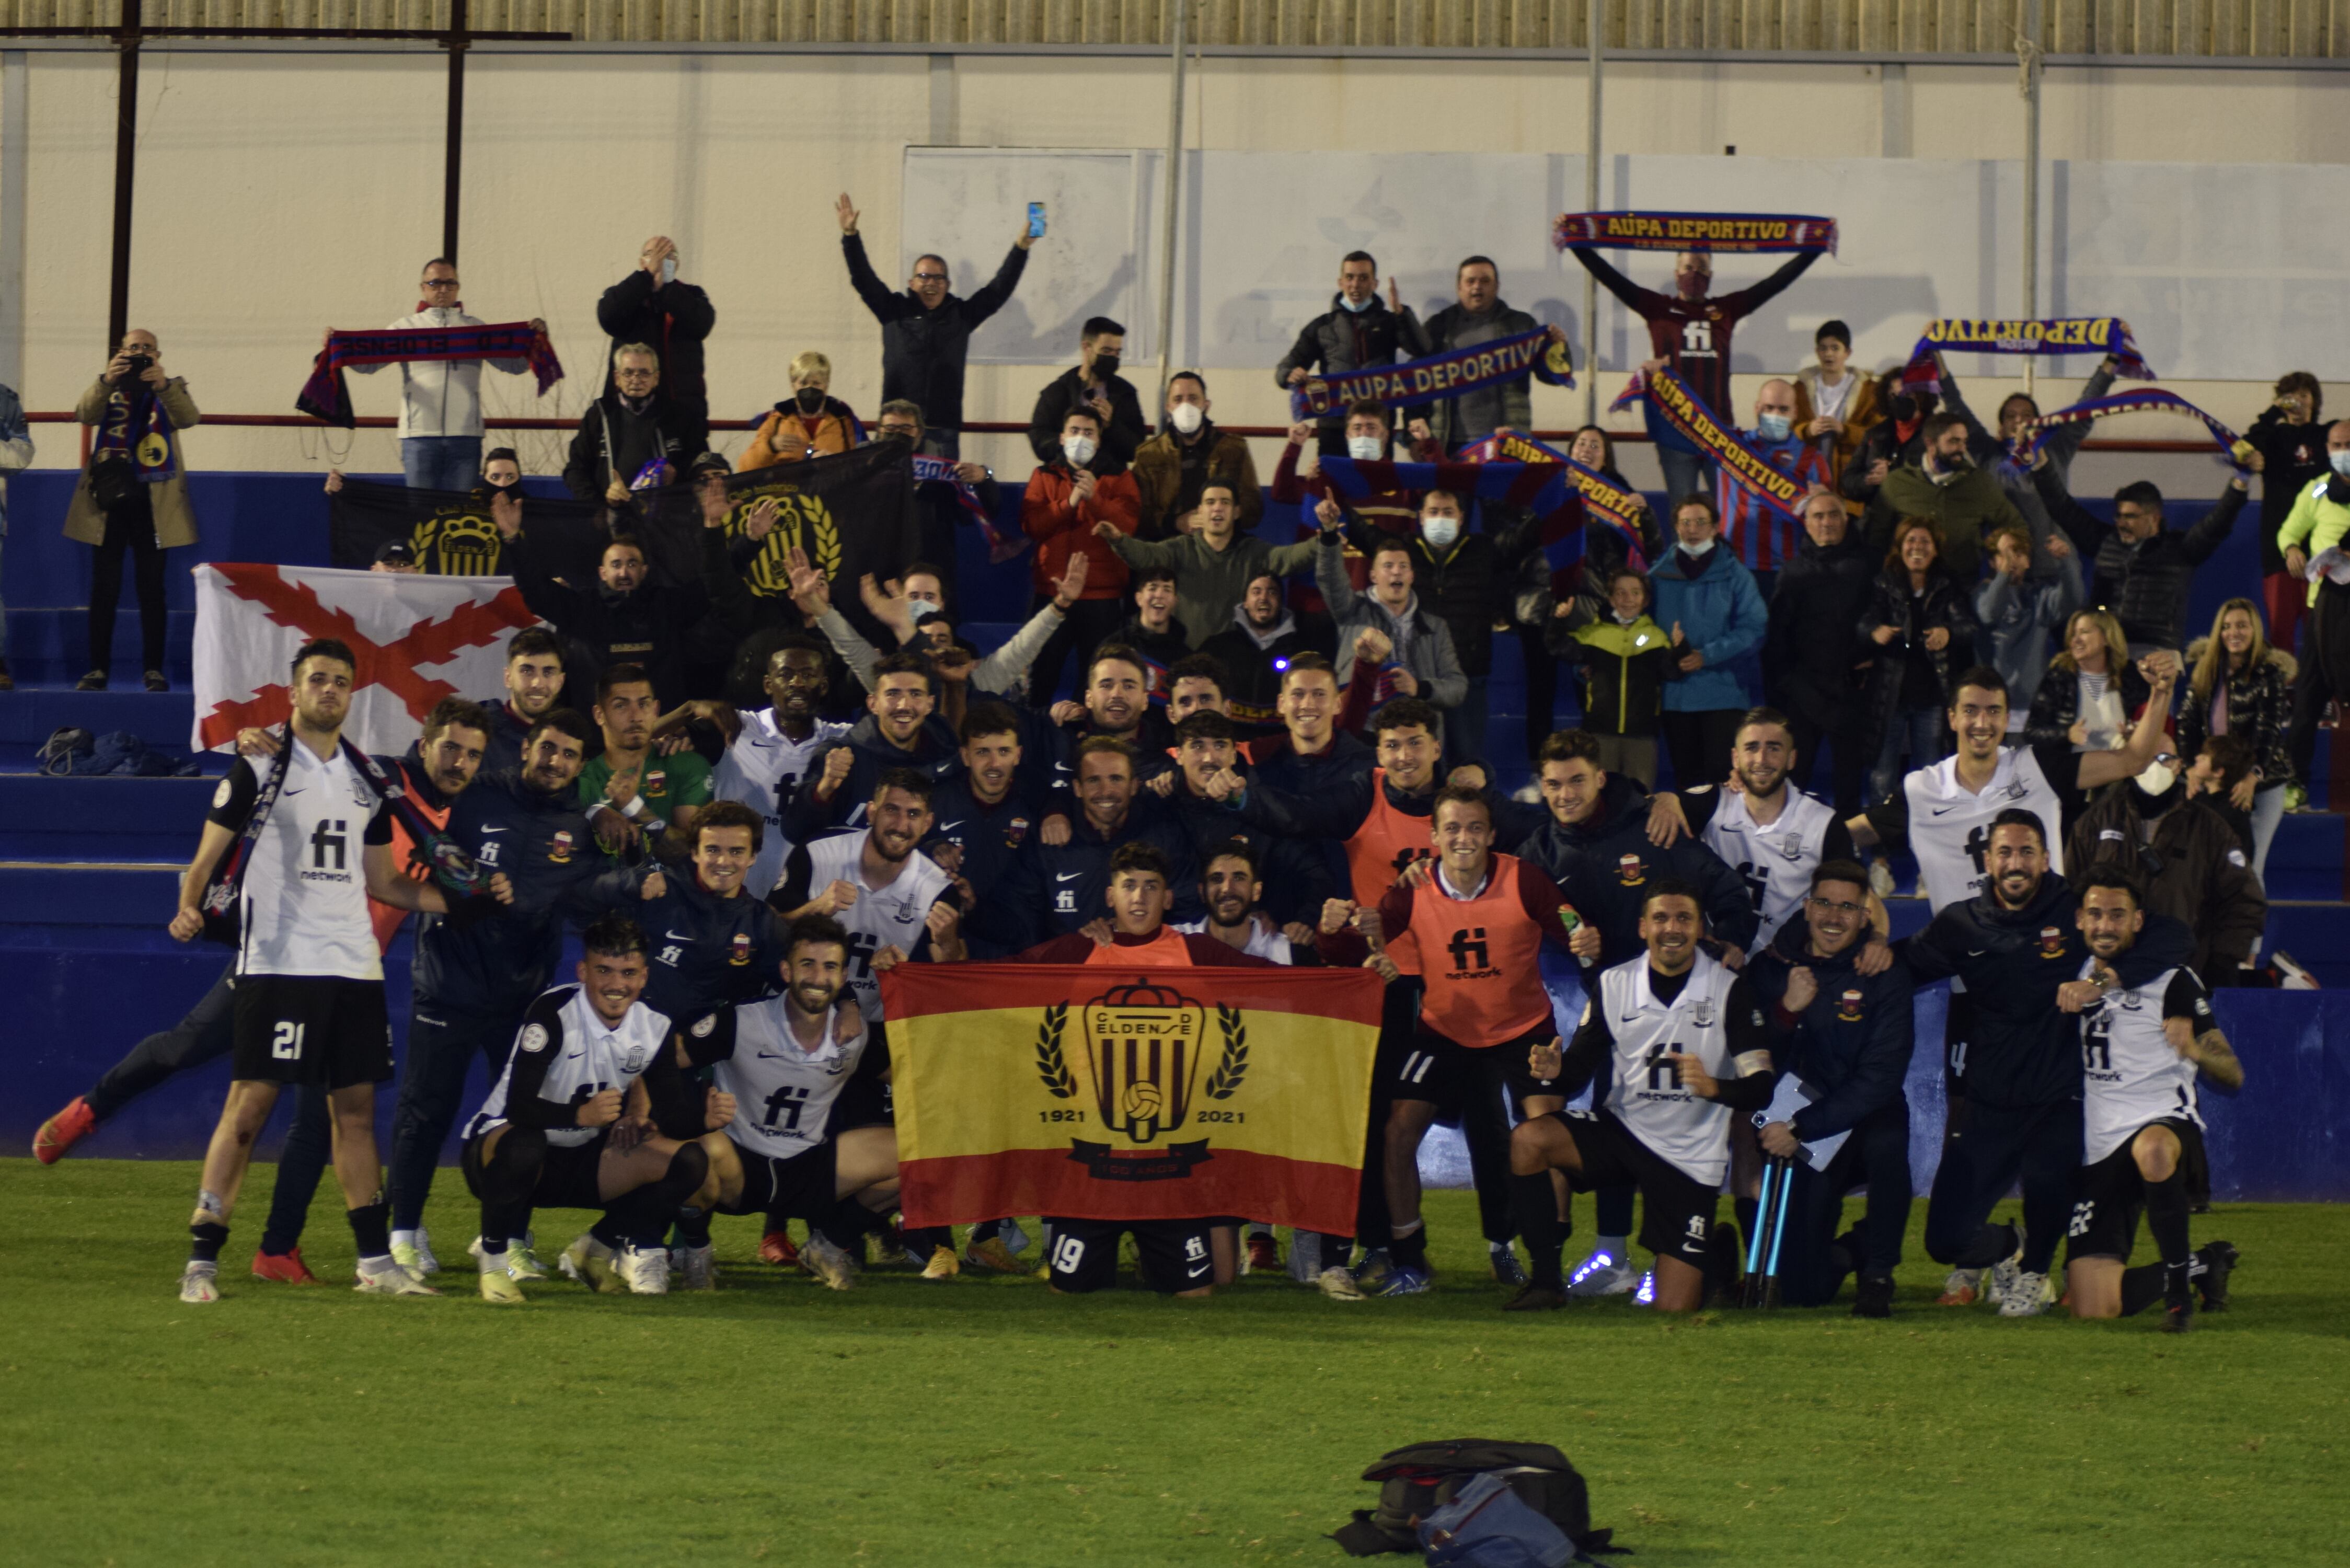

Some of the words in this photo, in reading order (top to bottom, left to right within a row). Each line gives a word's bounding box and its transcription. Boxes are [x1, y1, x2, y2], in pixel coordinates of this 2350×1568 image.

[1668, 218, 1788, 240] DEPORTIVO
[1692, 412, 1797, 500] DEPORTIVO
[310, 818, 347, 870] fi
[1055, 890, 1075, 908] fi
[1447, 927, 1488, 970] fi
[271, 1021, 305, 1060] 21
[1097, 1023, 1192, 1034] ELDENSE
[764, 1086, 810, 1129] fi
[1039, 1110, 1085, 1123] 1921
[1197, 1110, 1246, 1124] 2021
[1051, 1233, 1086, 1274] 19
[1184, 1236, 1205, 1256] fi
